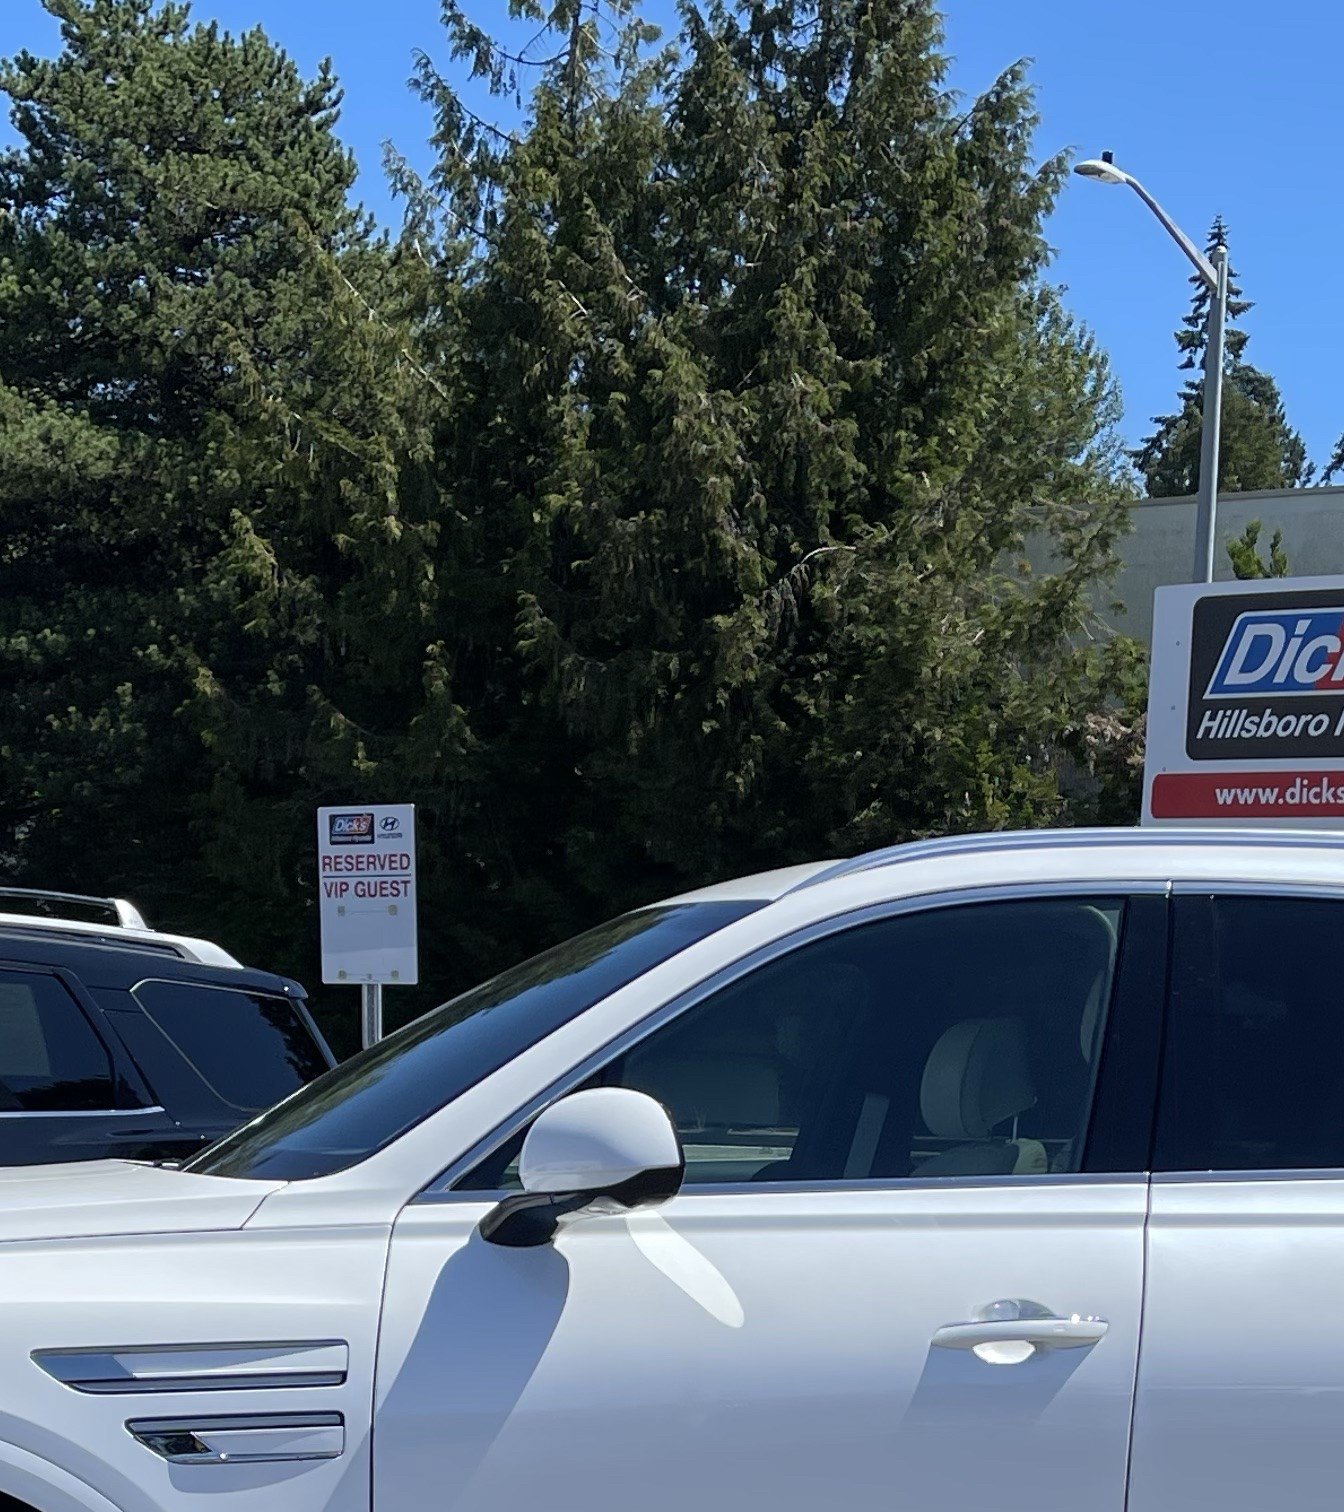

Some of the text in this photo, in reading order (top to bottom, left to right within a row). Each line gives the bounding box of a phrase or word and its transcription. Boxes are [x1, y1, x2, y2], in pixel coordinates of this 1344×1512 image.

[1196, 707, 1330, 739] Hillsboro
[322, 853, 411, 872] RESERVED
[323, 880, 411, 898] VIP GUEST
